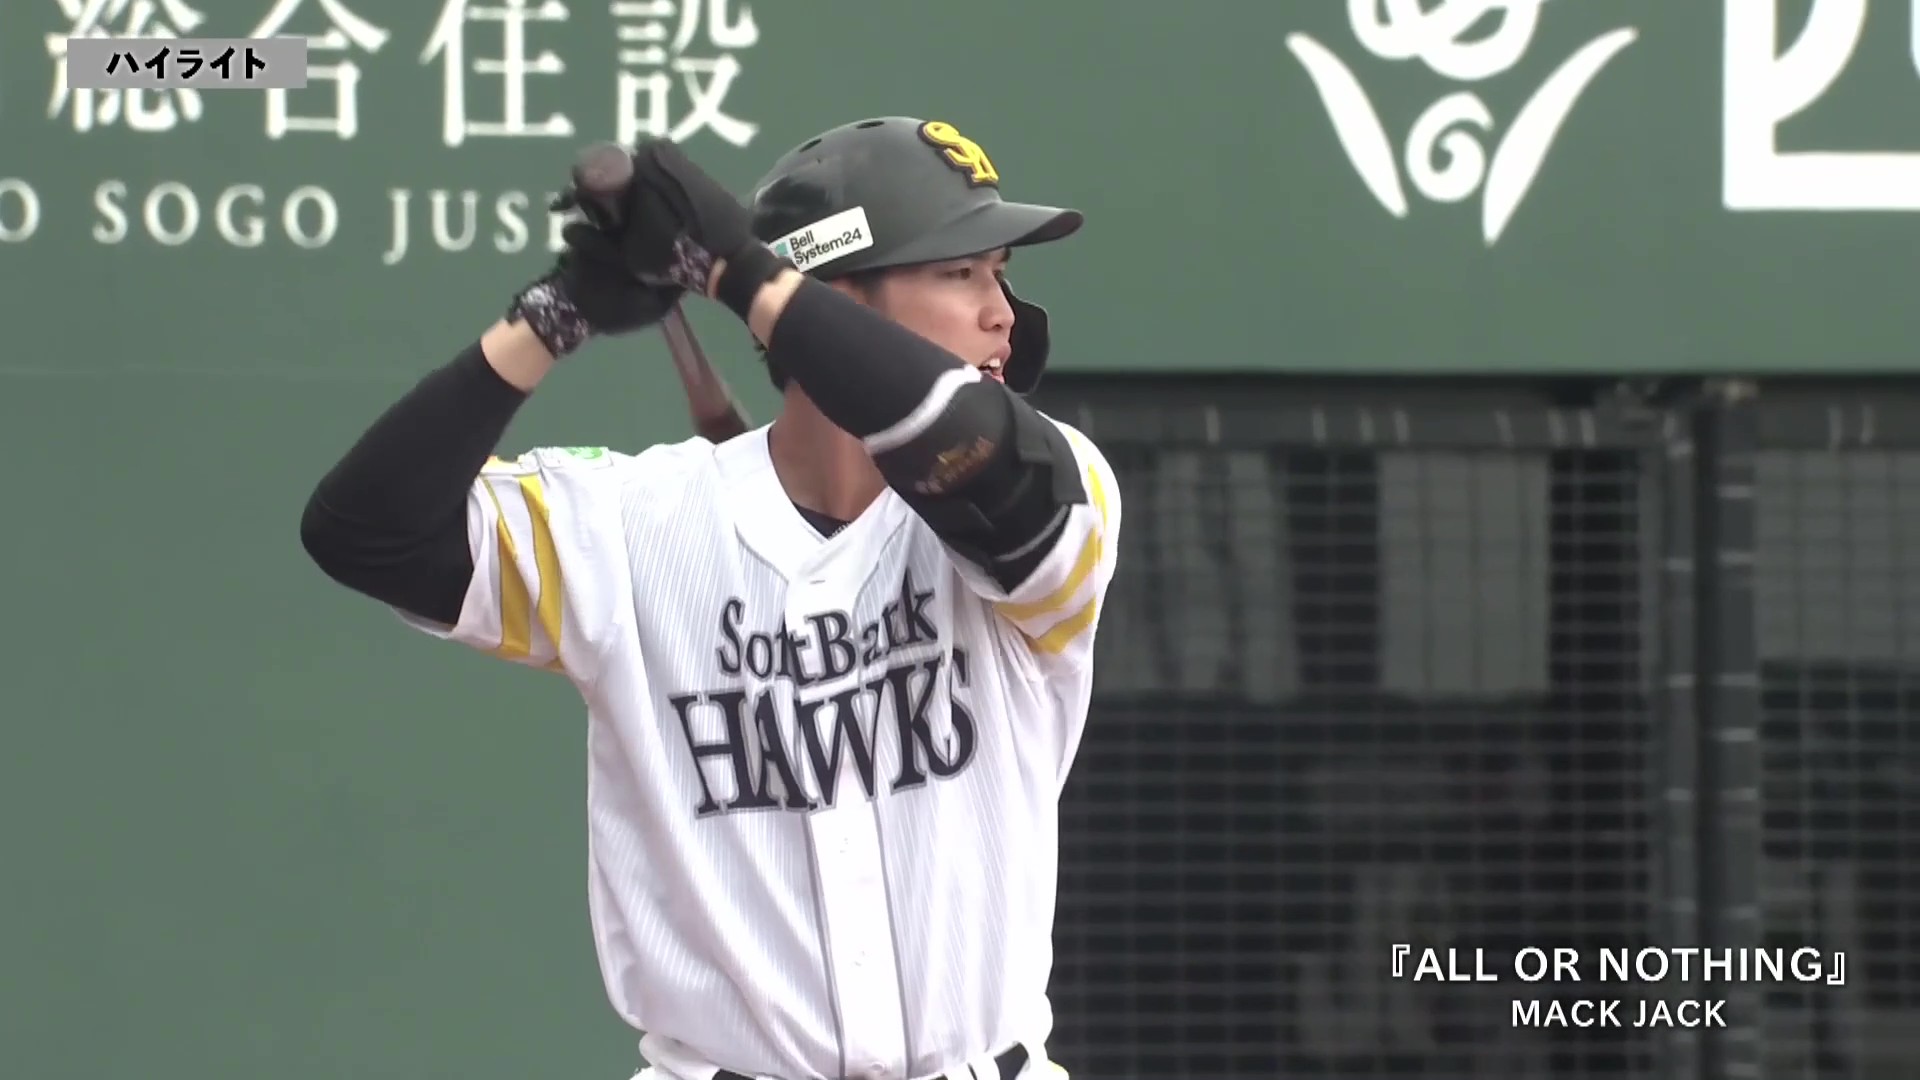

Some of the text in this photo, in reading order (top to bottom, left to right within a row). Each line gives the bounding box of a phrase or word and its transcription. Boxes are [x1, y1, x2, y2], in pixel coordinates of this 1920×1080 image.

[92, 180, 339, 249] SOGO
[789, 230, 815, 252] Bell
[793, 227, 863, 265] System24
[667, 648, 979, 819] HAWKS
